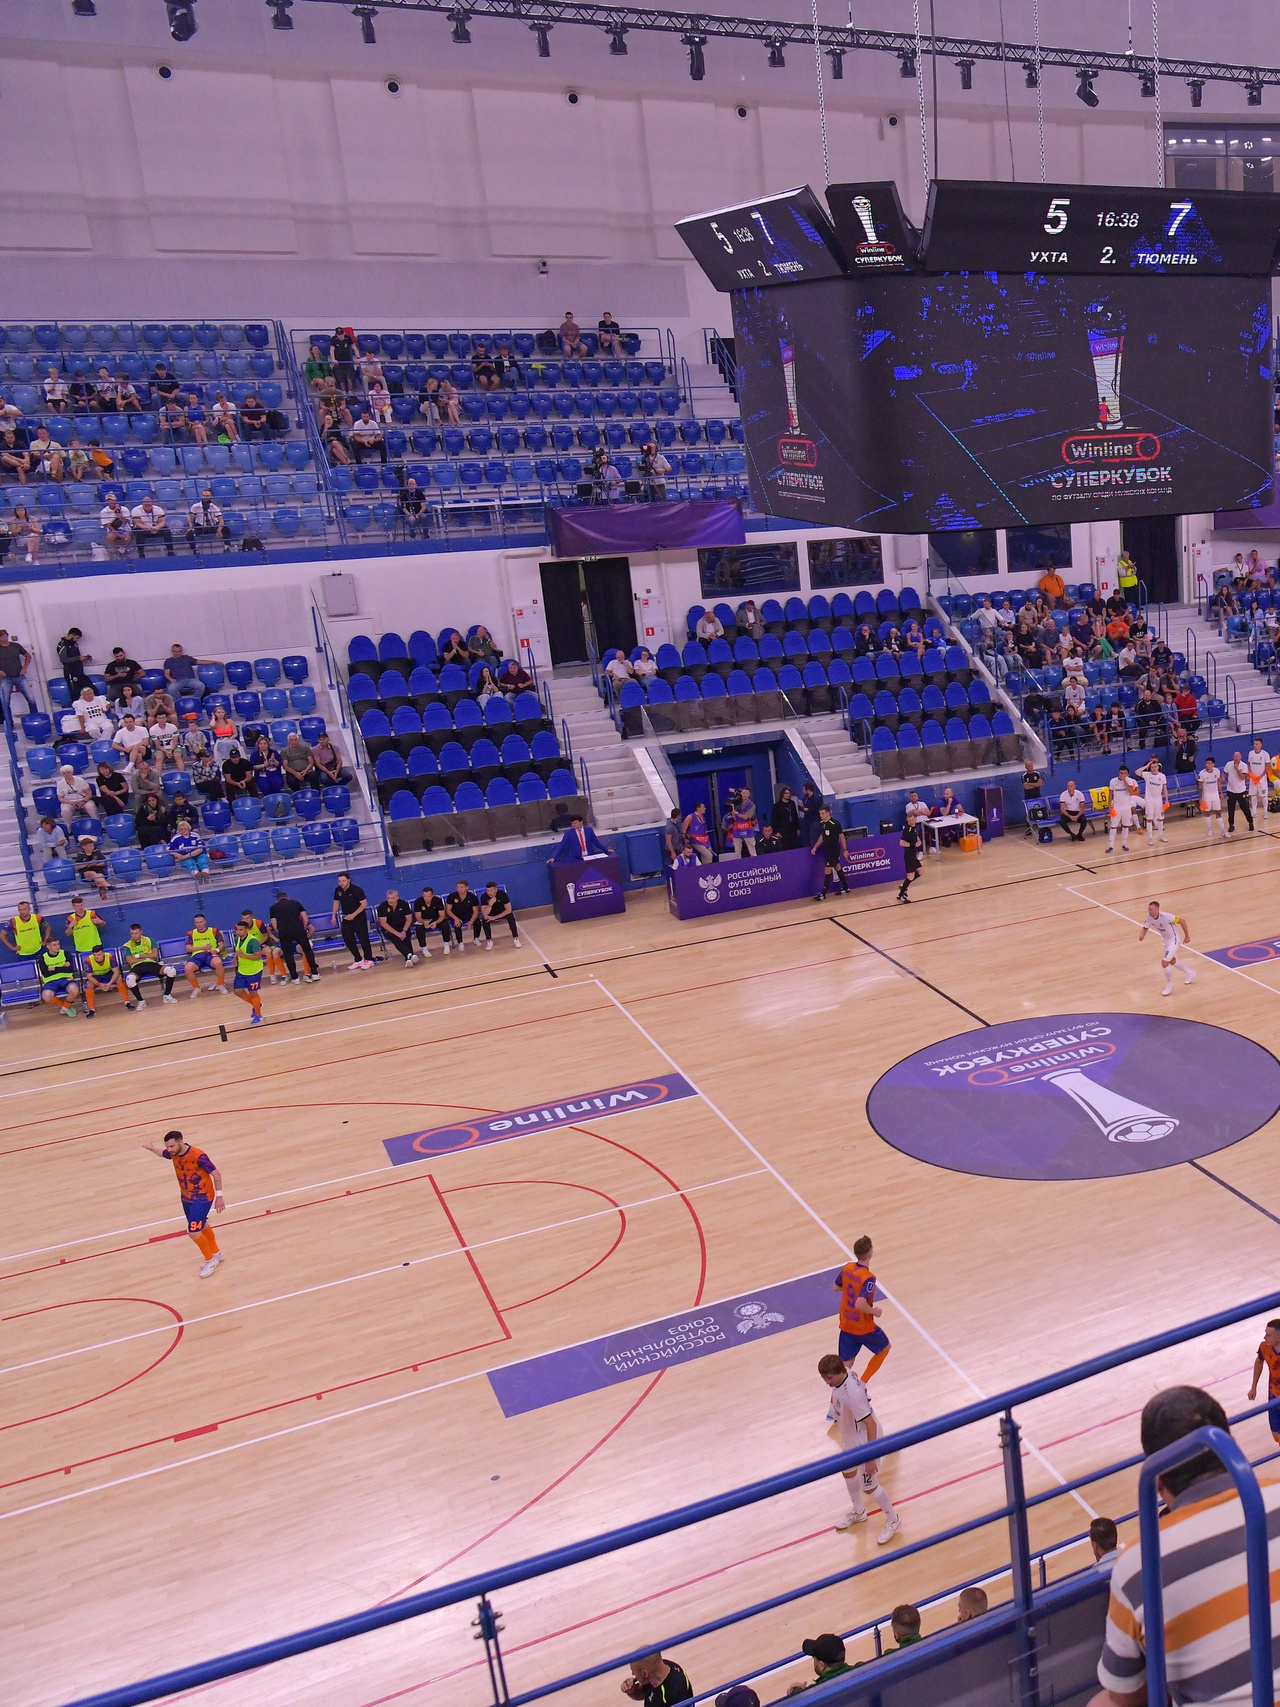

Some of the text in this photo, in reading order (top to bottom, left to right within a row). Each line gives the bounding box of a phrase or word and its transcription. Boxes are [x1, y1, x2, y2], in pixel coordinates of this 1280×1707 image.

[1044, 199, 1193, 236] 5 16:38 7
[710, 222, 734, 255] 5
[750, 212, 774, 245] 7
[854, 255, 904, 264] СУПЕРКУБОК
[1030, 246, 1198, 265] УХТА 2. ТЮМЕНЬ
[1071, 442, 1133, 458] Winline
[778, 470, 825, 491] СУПЕРКУБОК
[1050, 466, 1172, 488] СУПЕРКУБОК
[842, 859, 891, 872] СУПЕРКУБОК
[850, 852, 875, 860] Winline
[728, 864, 778, 880] РОССИЙСКИЙ
[728, 872, 782, 888] ФУТБОЛЬНЫЙ
[729, 888, 751, 897] СОЮЗ
[250, 982, 259, 990] 77
[931, 1027, 1112, 1077] СУПЕРКУБОК
[1009, 1046, 1105, 1073] Winline
[488, 1088, 648, 1133] Winline
[190, 1220, 203, 1231] 94
[668, 1316, 715, 1335] СОЮЗ
[604, 1324, 720, 1366] ФУТБОЛЬНЫЙ
[615, 1332, 726, 1372] РОССИЙСКИЙ
